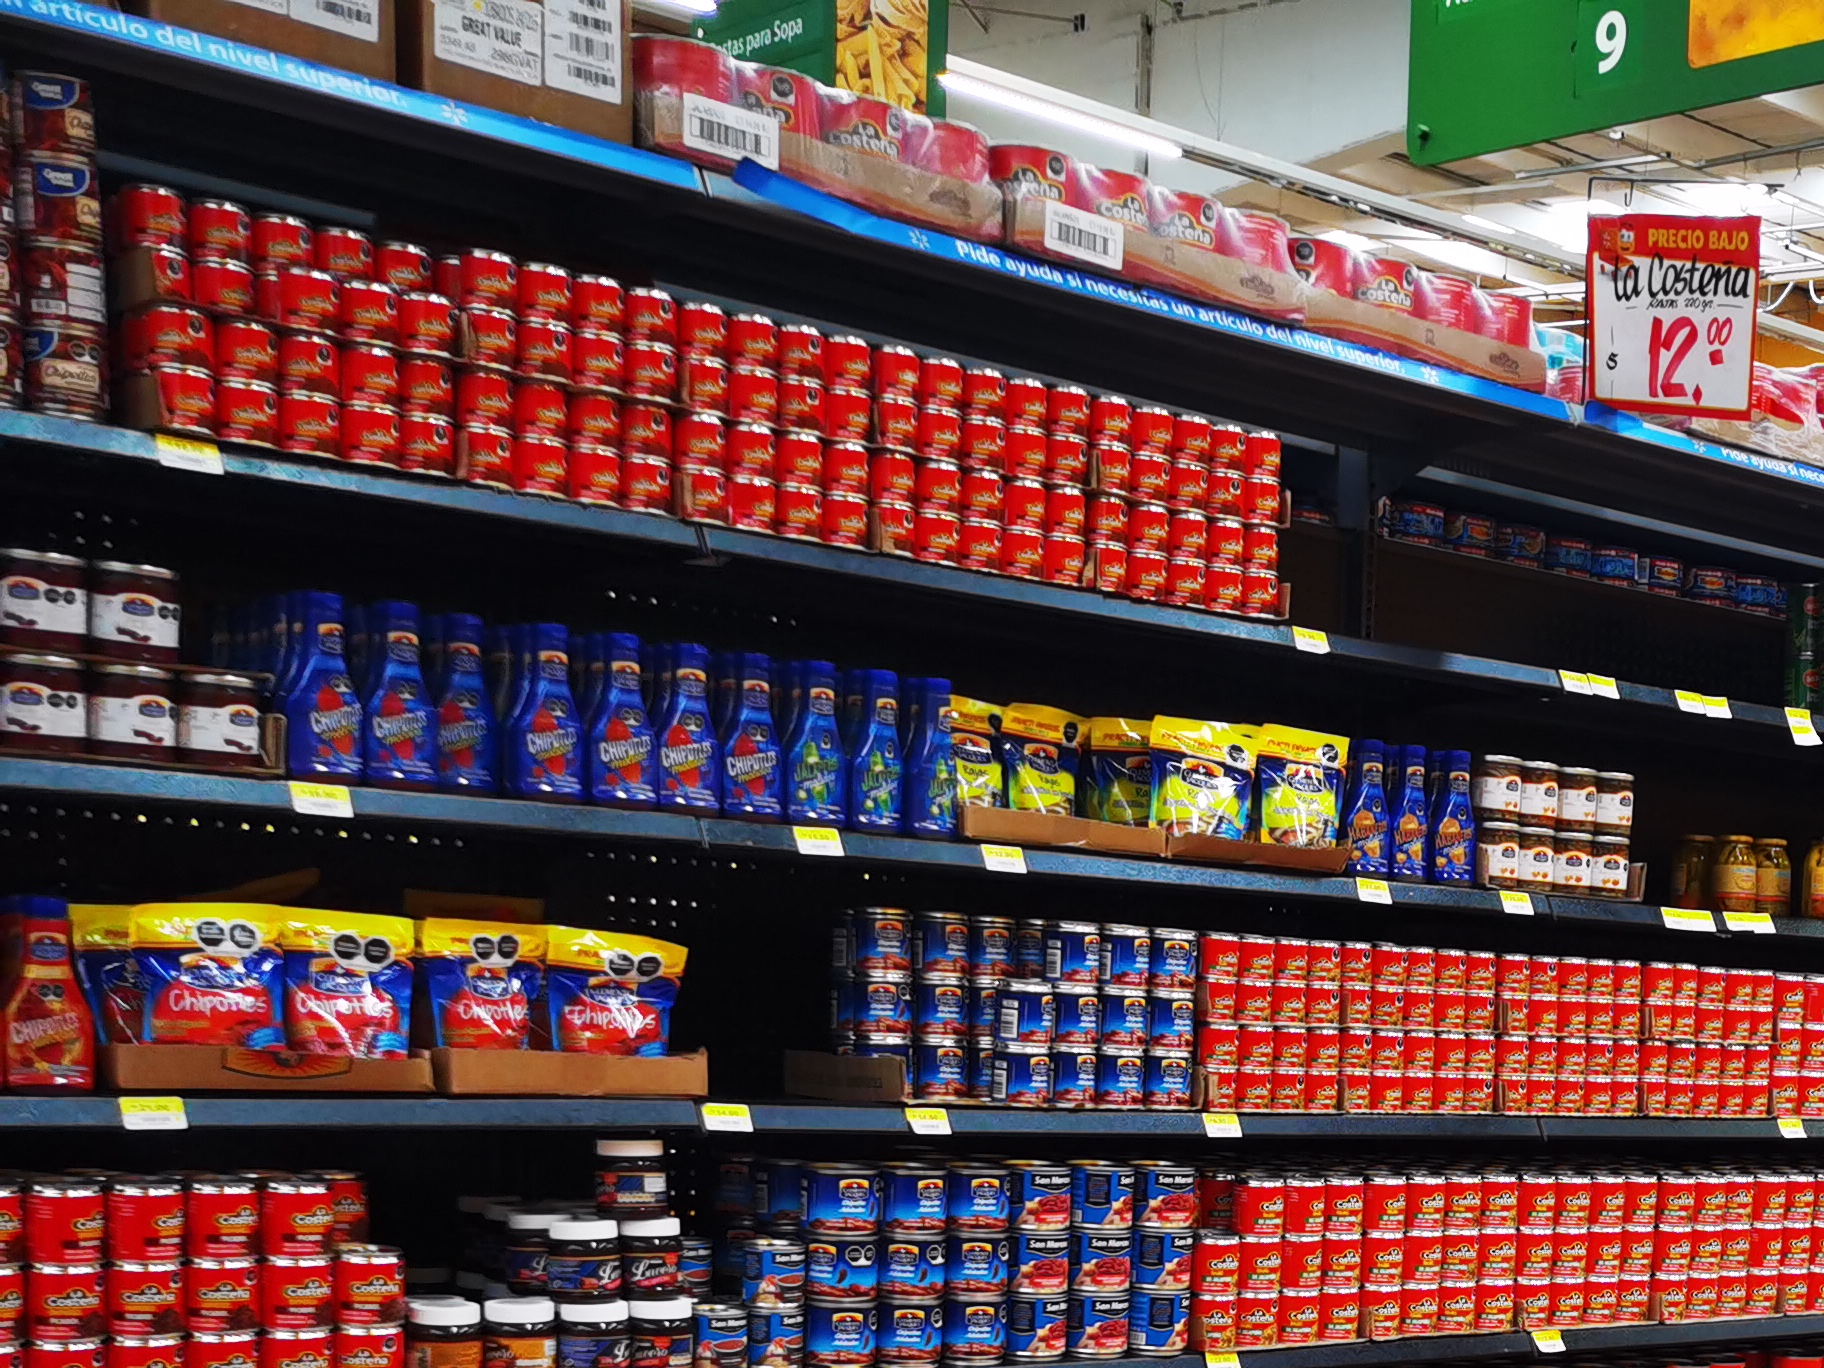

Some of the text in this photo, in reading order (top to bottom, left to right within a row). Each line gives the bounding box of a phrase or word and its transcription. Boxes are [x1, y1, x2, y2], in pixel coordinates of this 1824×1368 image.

[155, 24, 200, 53] del
[209, 43, 279, 73] nivel
[746, 28, 772, 58] para
[774, 18, 803, 43] Sopa
[1595, 11, 1627, 74] 9
[1648, 228, 1749, 251] PRECIO BAJO
[955, 240, 1001, 267] Pide
[1005, 258, 1063, 284] ayuda
[1066, 271, 1083, 289] si
[1085, 279, 1168, 312] necesitas
[1171, 302, 1195, 318] un
[1266, 325, 1293, 343] del
[1294, 330, 1334, 355] nivel
